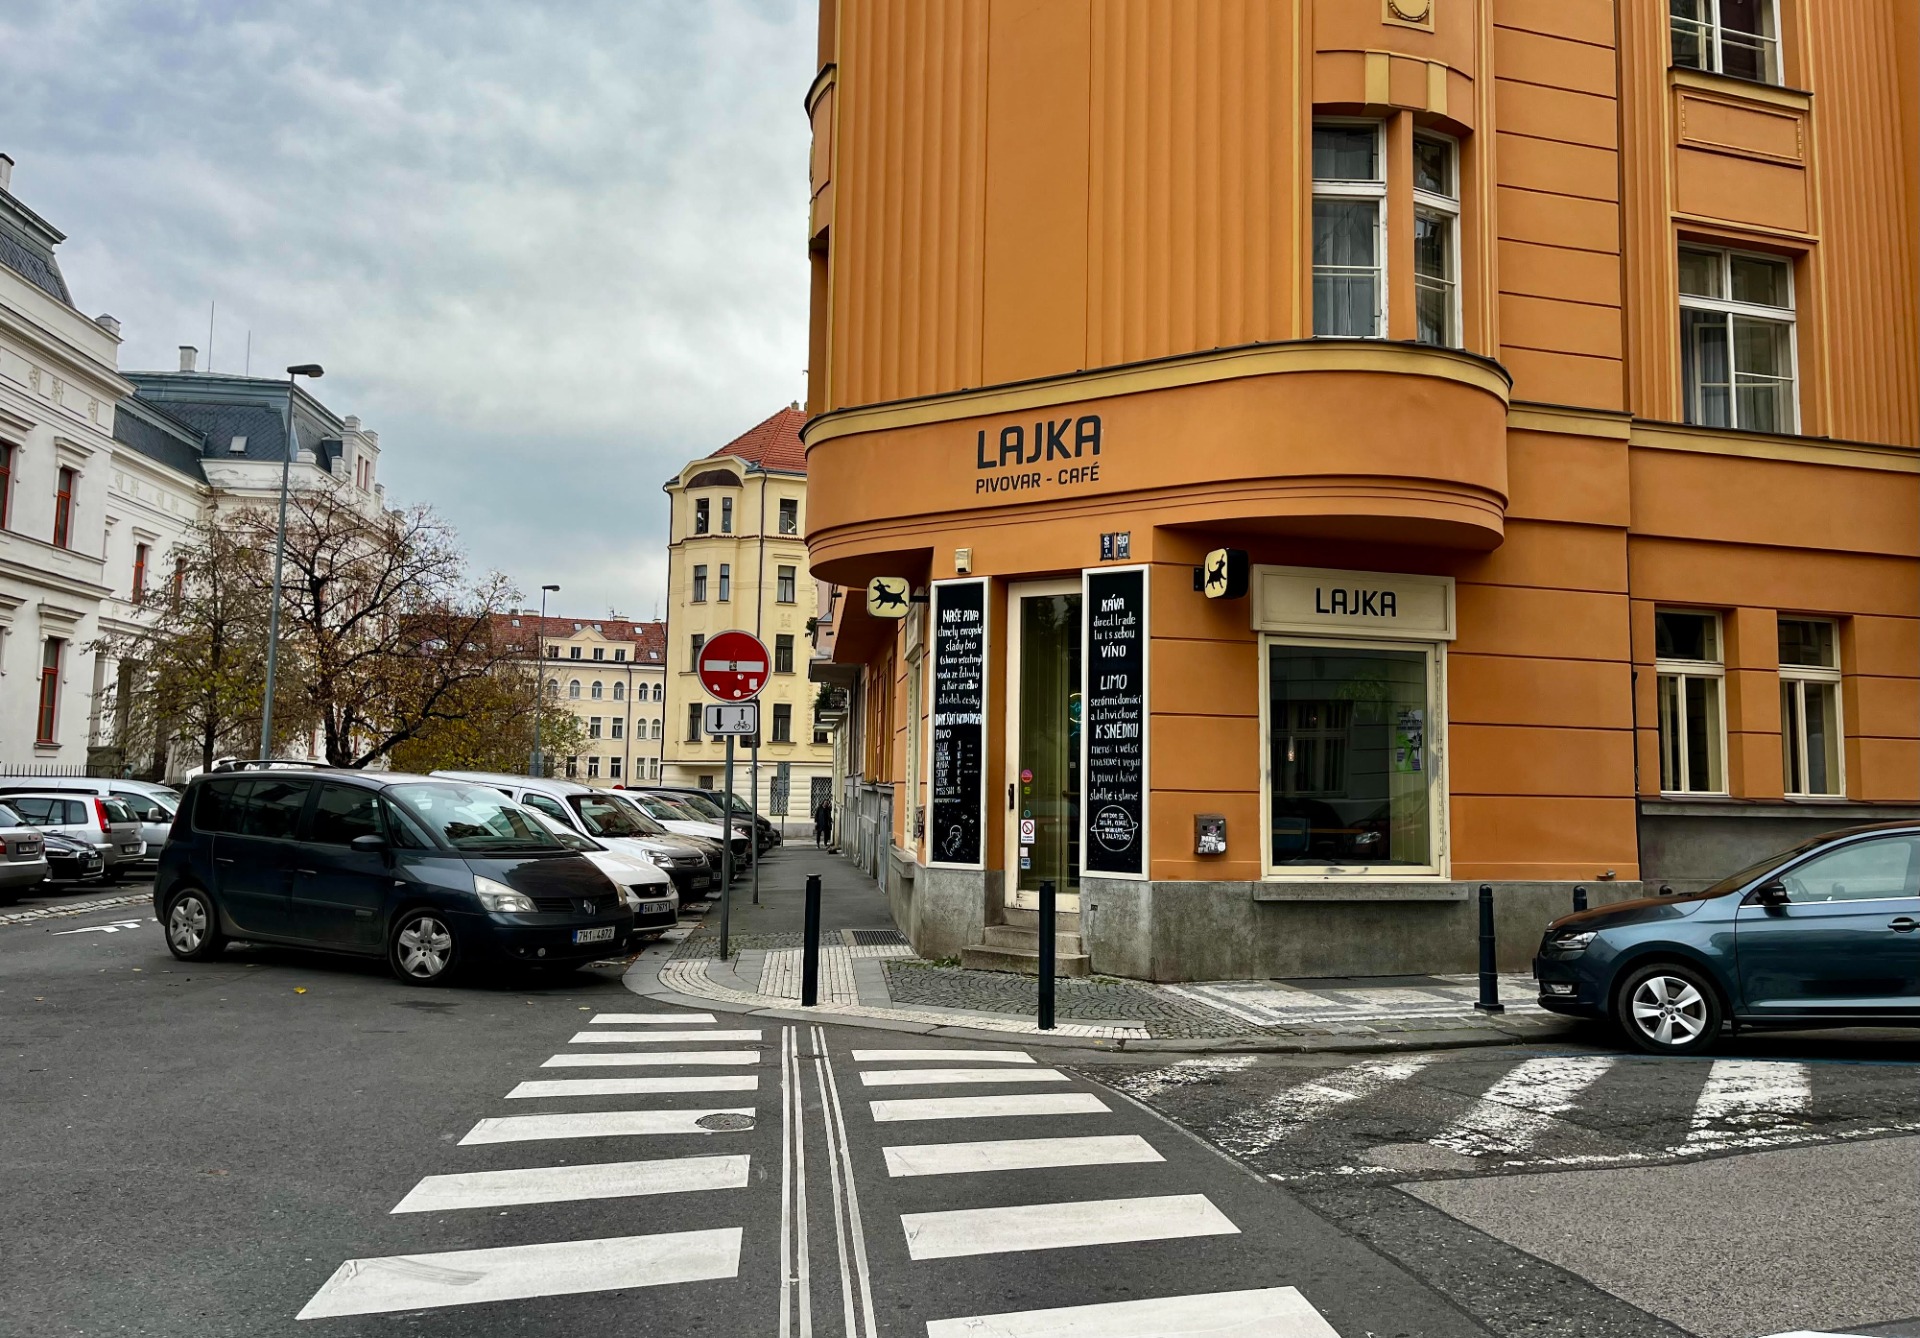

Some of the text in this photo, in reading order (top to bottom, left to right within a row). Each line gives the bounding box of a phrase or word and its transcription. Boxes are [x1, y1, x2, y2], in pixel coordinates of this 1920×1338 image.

[977, 415, 1101, 469] LAJKA
[976, 472, 1041, 494] PIVOVAR
[1058, 461, 1100, 485] CAFÉ
[1101, 593, 1125, 612] KÁVA
[1316, 587, 1397, 617] LAJKA
[942, 608, 962, 623] NAŠE
[1115, 610, 1136, 626] trade
[1100, 641, 1127, 658] VÍNO
[1100, 674, 1128, 690] LIMO
[1090, 713, 1096, 721] a
[935, 729, 951, 740] PIVO
[1095, 724, 1103, 739] K
[578, 927, 613, 940] 7H1 4972
